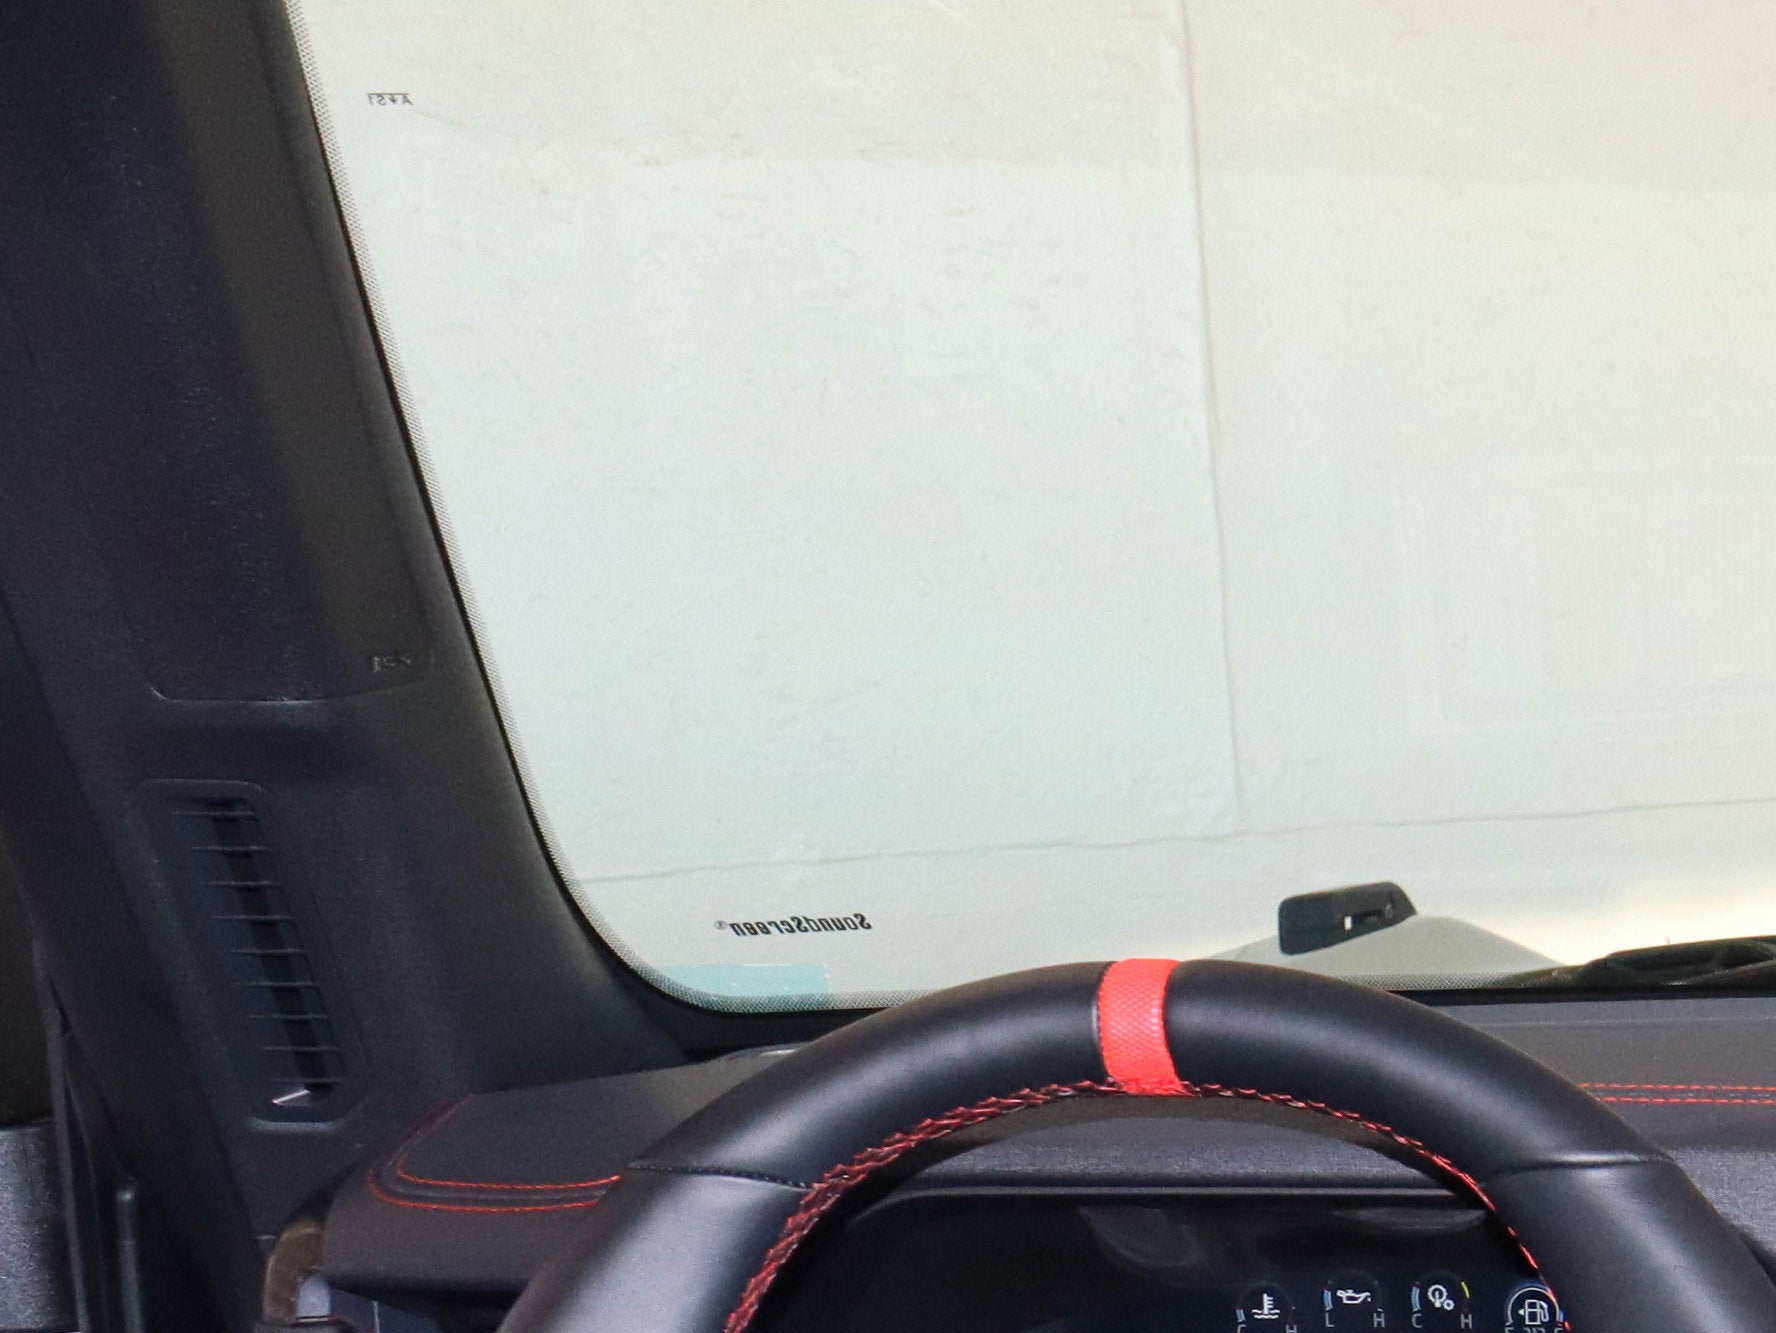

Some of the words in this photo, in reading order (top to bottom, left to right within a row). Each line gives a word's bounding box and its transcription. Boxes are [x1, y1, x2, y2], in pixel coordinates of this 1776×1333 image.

[1325, 1313, 1334, 1328] L
[1373, 1313, 1385, 1328] H
[1412, 1314, 1423, 1328] C
[1460, 1315, 1473, 1329] H
